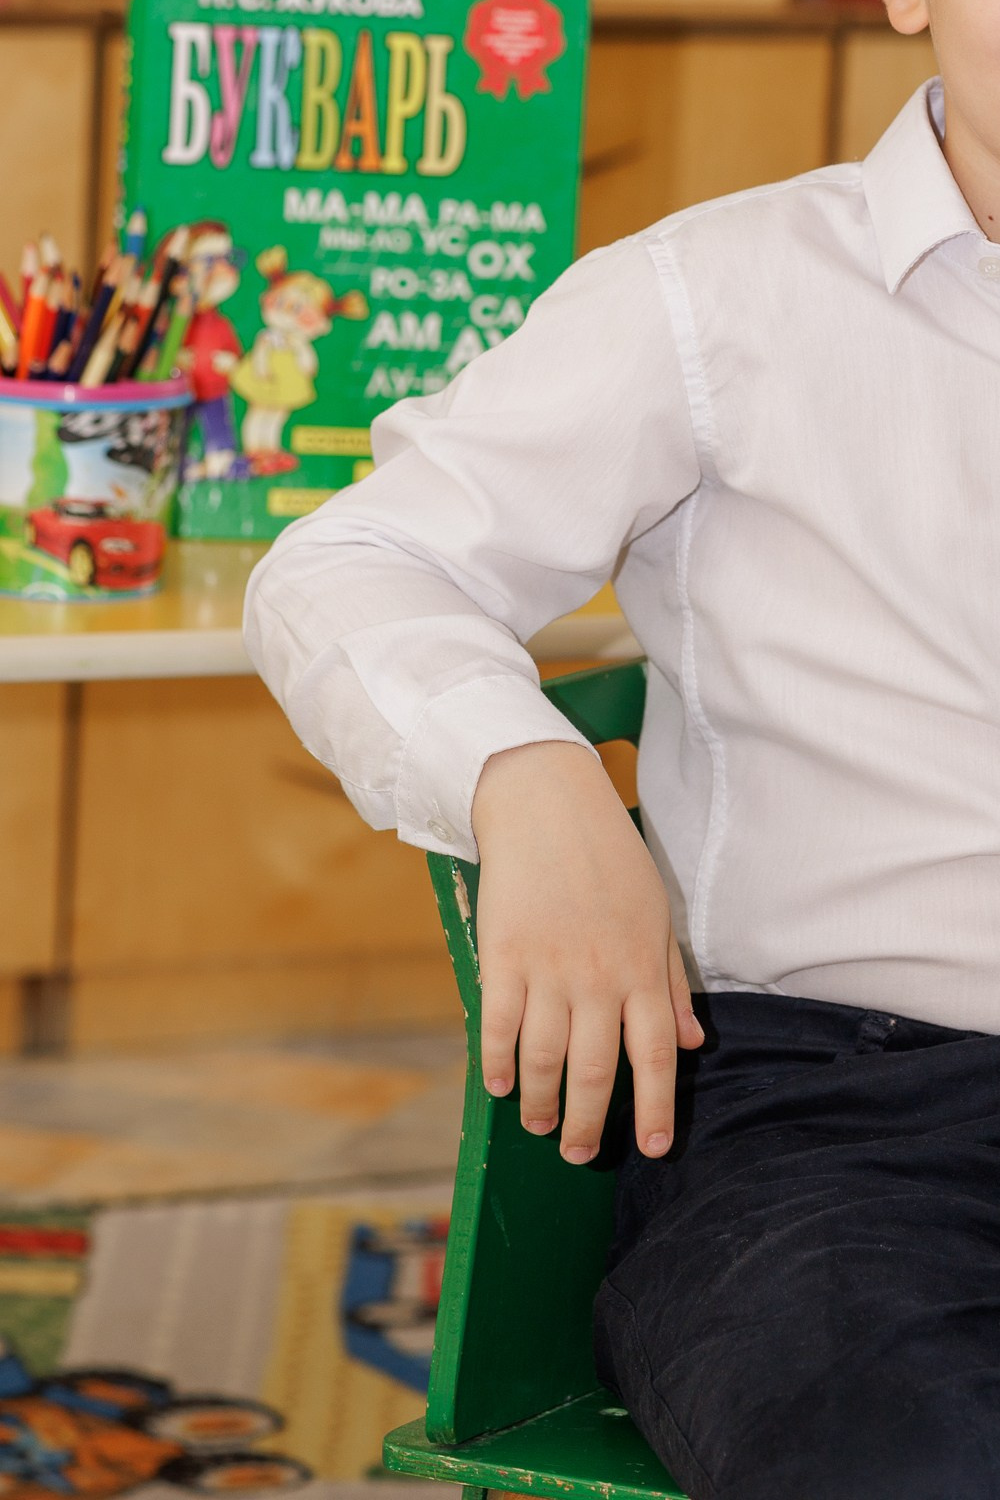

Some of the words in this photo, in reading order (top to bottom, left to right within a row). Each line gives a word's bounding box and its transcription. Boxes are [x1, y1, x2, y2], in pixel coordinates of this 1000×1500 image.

[162, 21, 468, 177] БУКВАРЬ
[283, 187, 430, 229] МА-МА
[438, 198, 547, 234] РА-МА
[466, 240, 536, 282] ОХ
[365, 310, 443, 350] АМ
